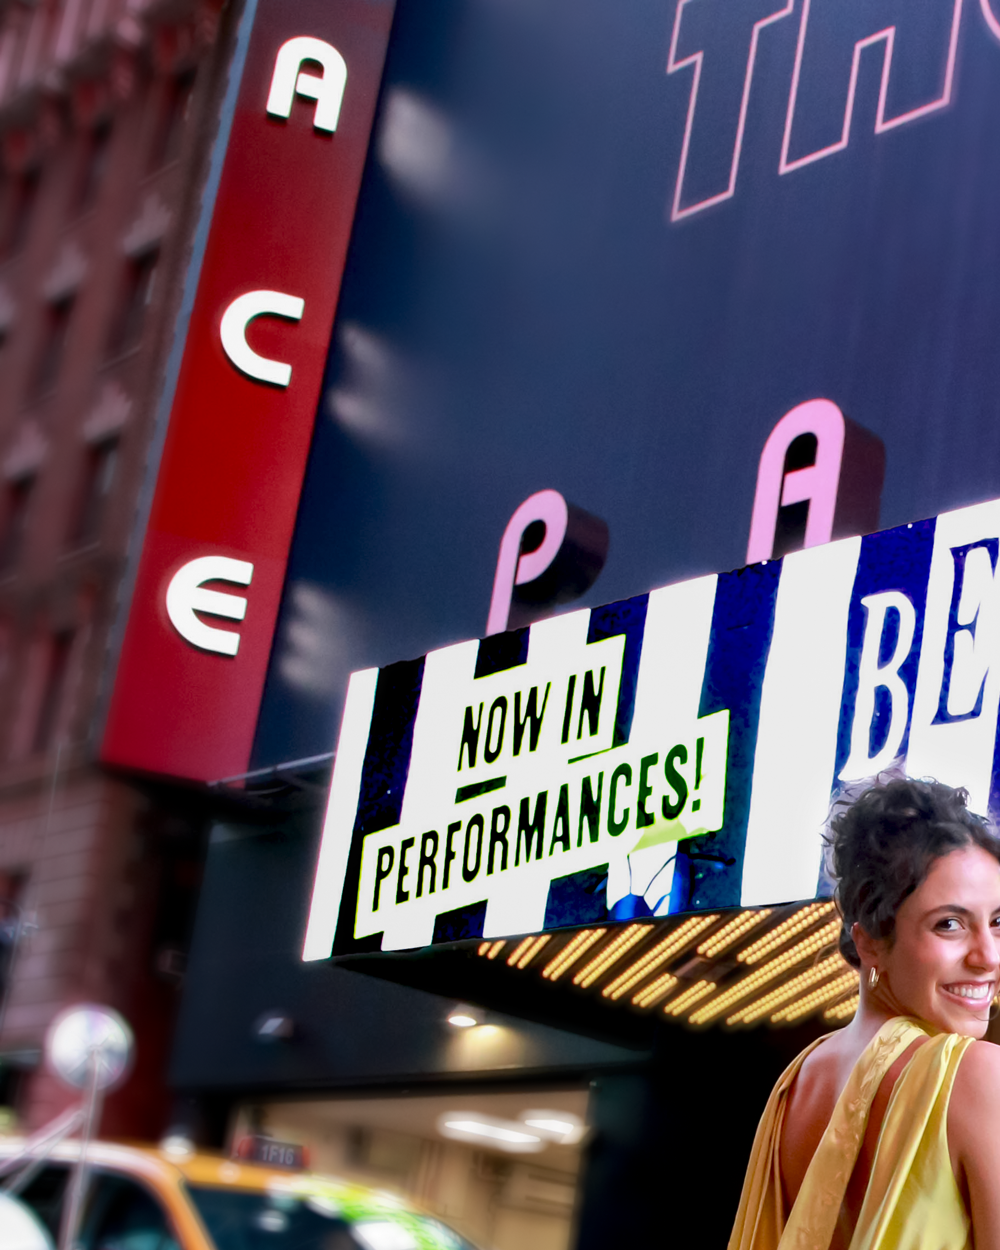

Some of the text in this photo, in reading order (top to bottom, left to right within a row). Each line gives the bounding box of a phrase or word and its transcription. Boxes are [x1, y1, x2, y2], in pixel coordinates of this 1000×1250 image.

[457, 666, 606, 772] NOW IN
[372, 737, 704, 913] PERFORMANCES!
[262, 1144, 295, 1165] 1F16
